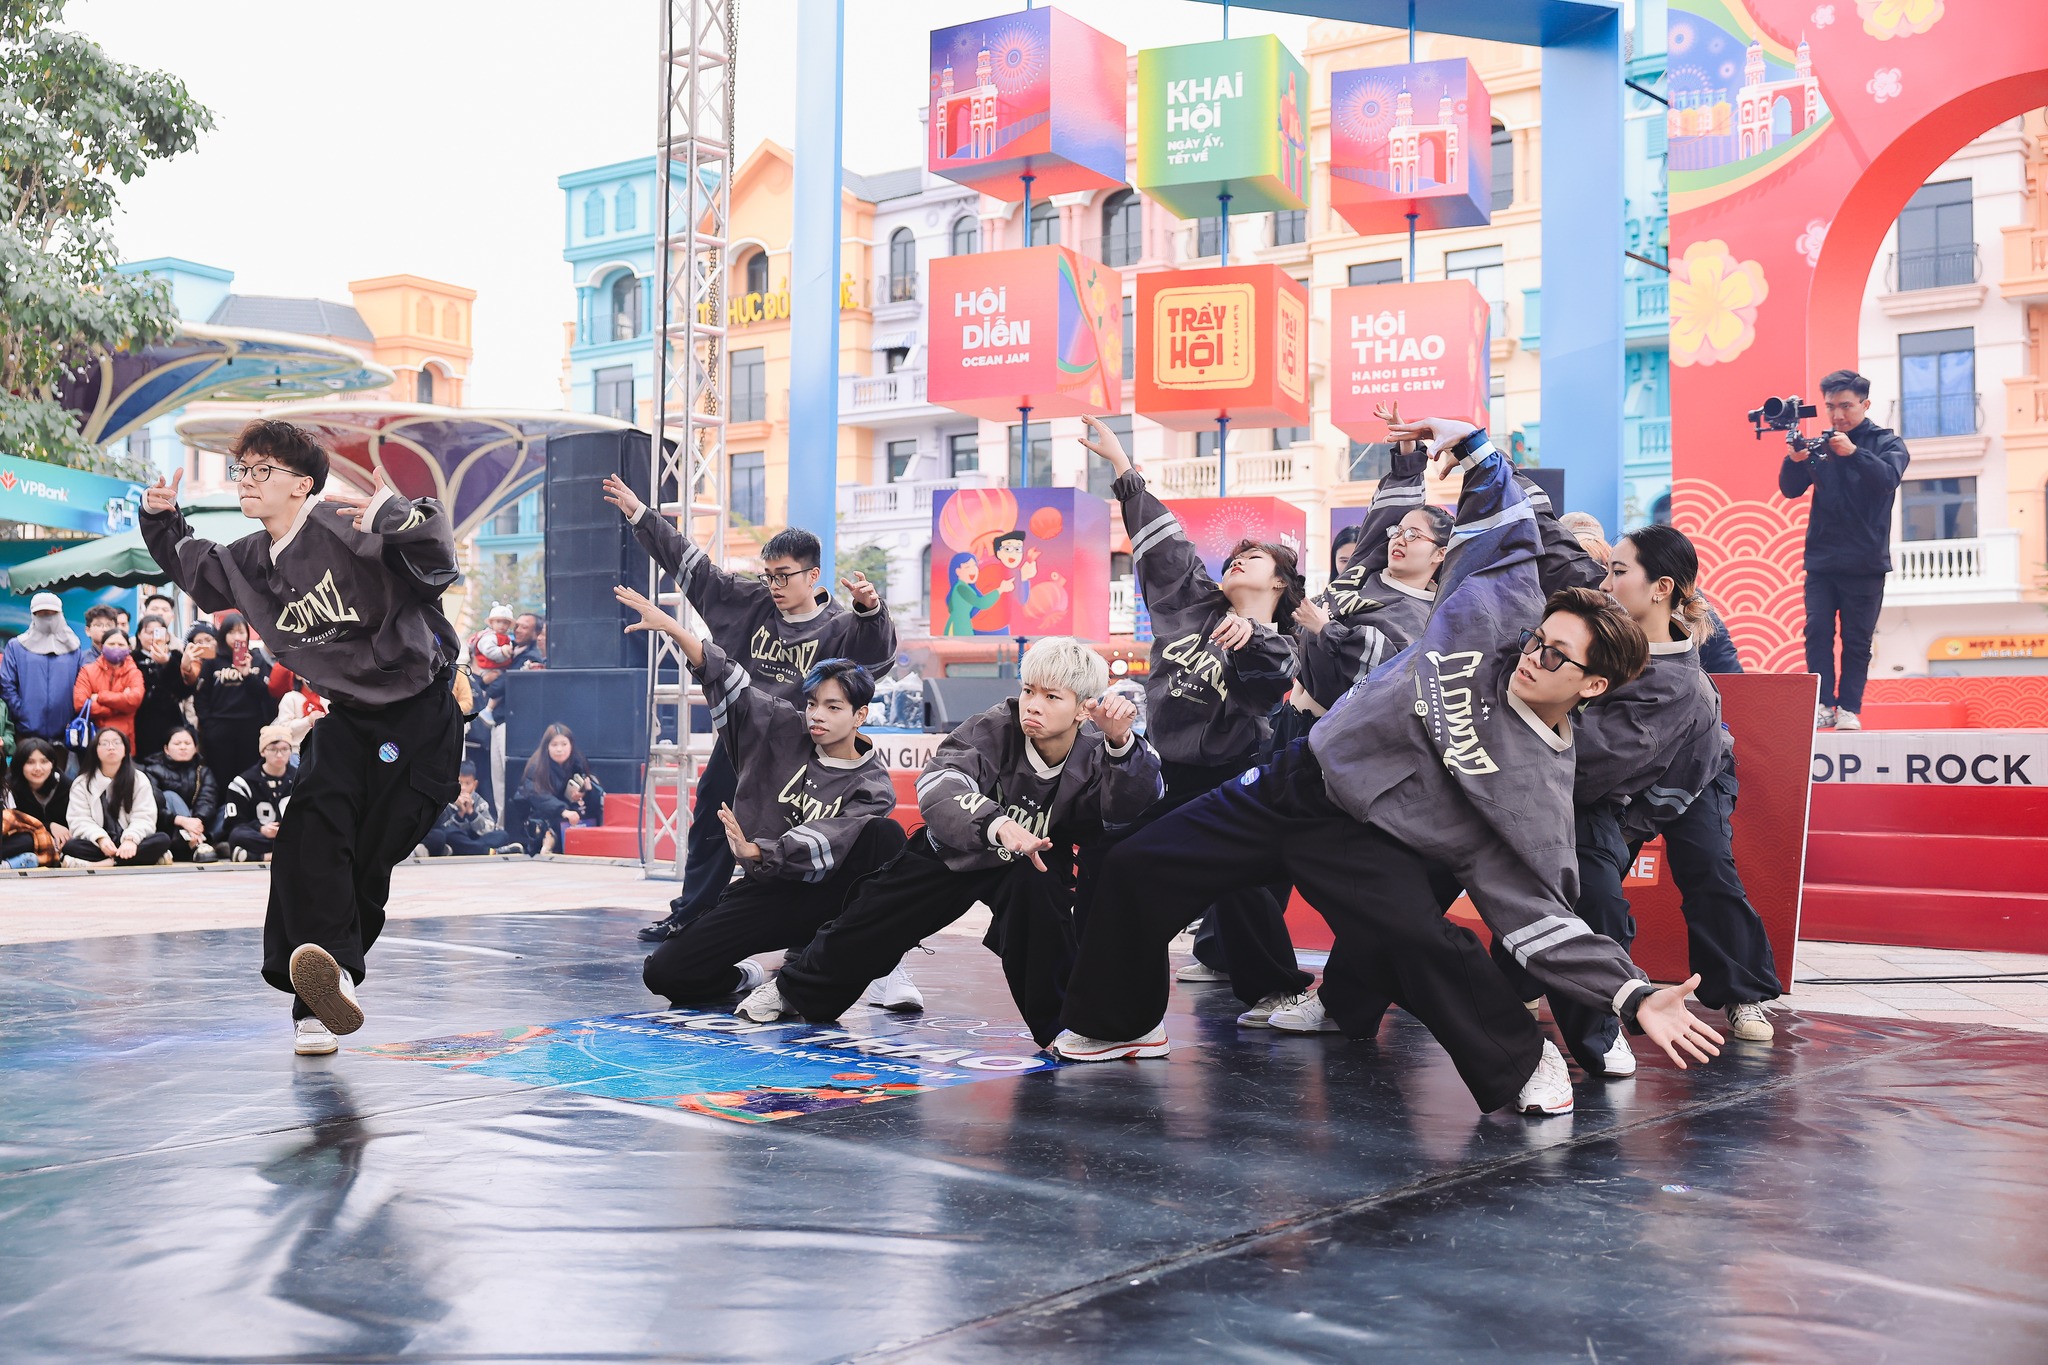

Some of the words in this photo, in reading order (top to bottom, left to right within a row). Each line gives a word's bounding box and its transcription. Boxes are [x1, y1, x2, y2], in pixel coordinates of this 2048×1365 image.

[1168, 150, 1190, 165] TẾT
[1167, 302, 1226, 333] TRẨY
[962, 355, 1003, 367] OCEAN
[1005, 352, 1029, 364] JAM
[1170, 333, 1223, 375] HỘI
[1351, 334, 1446, 364] THAO
[1352, 369, 1397, 381] HANOI
[1401, 366, 1437, 378] BEST
[1352, 383, 1399, 395] DANCE
[1403, 380, 1445, 391] CREW
[20, 479, 69, 502] VPBank
[1906, 753, 2032, 785] ROCK
[790, 1030, 1047, 1071] THAO
[856, 1062, 972, 1081] CREW
